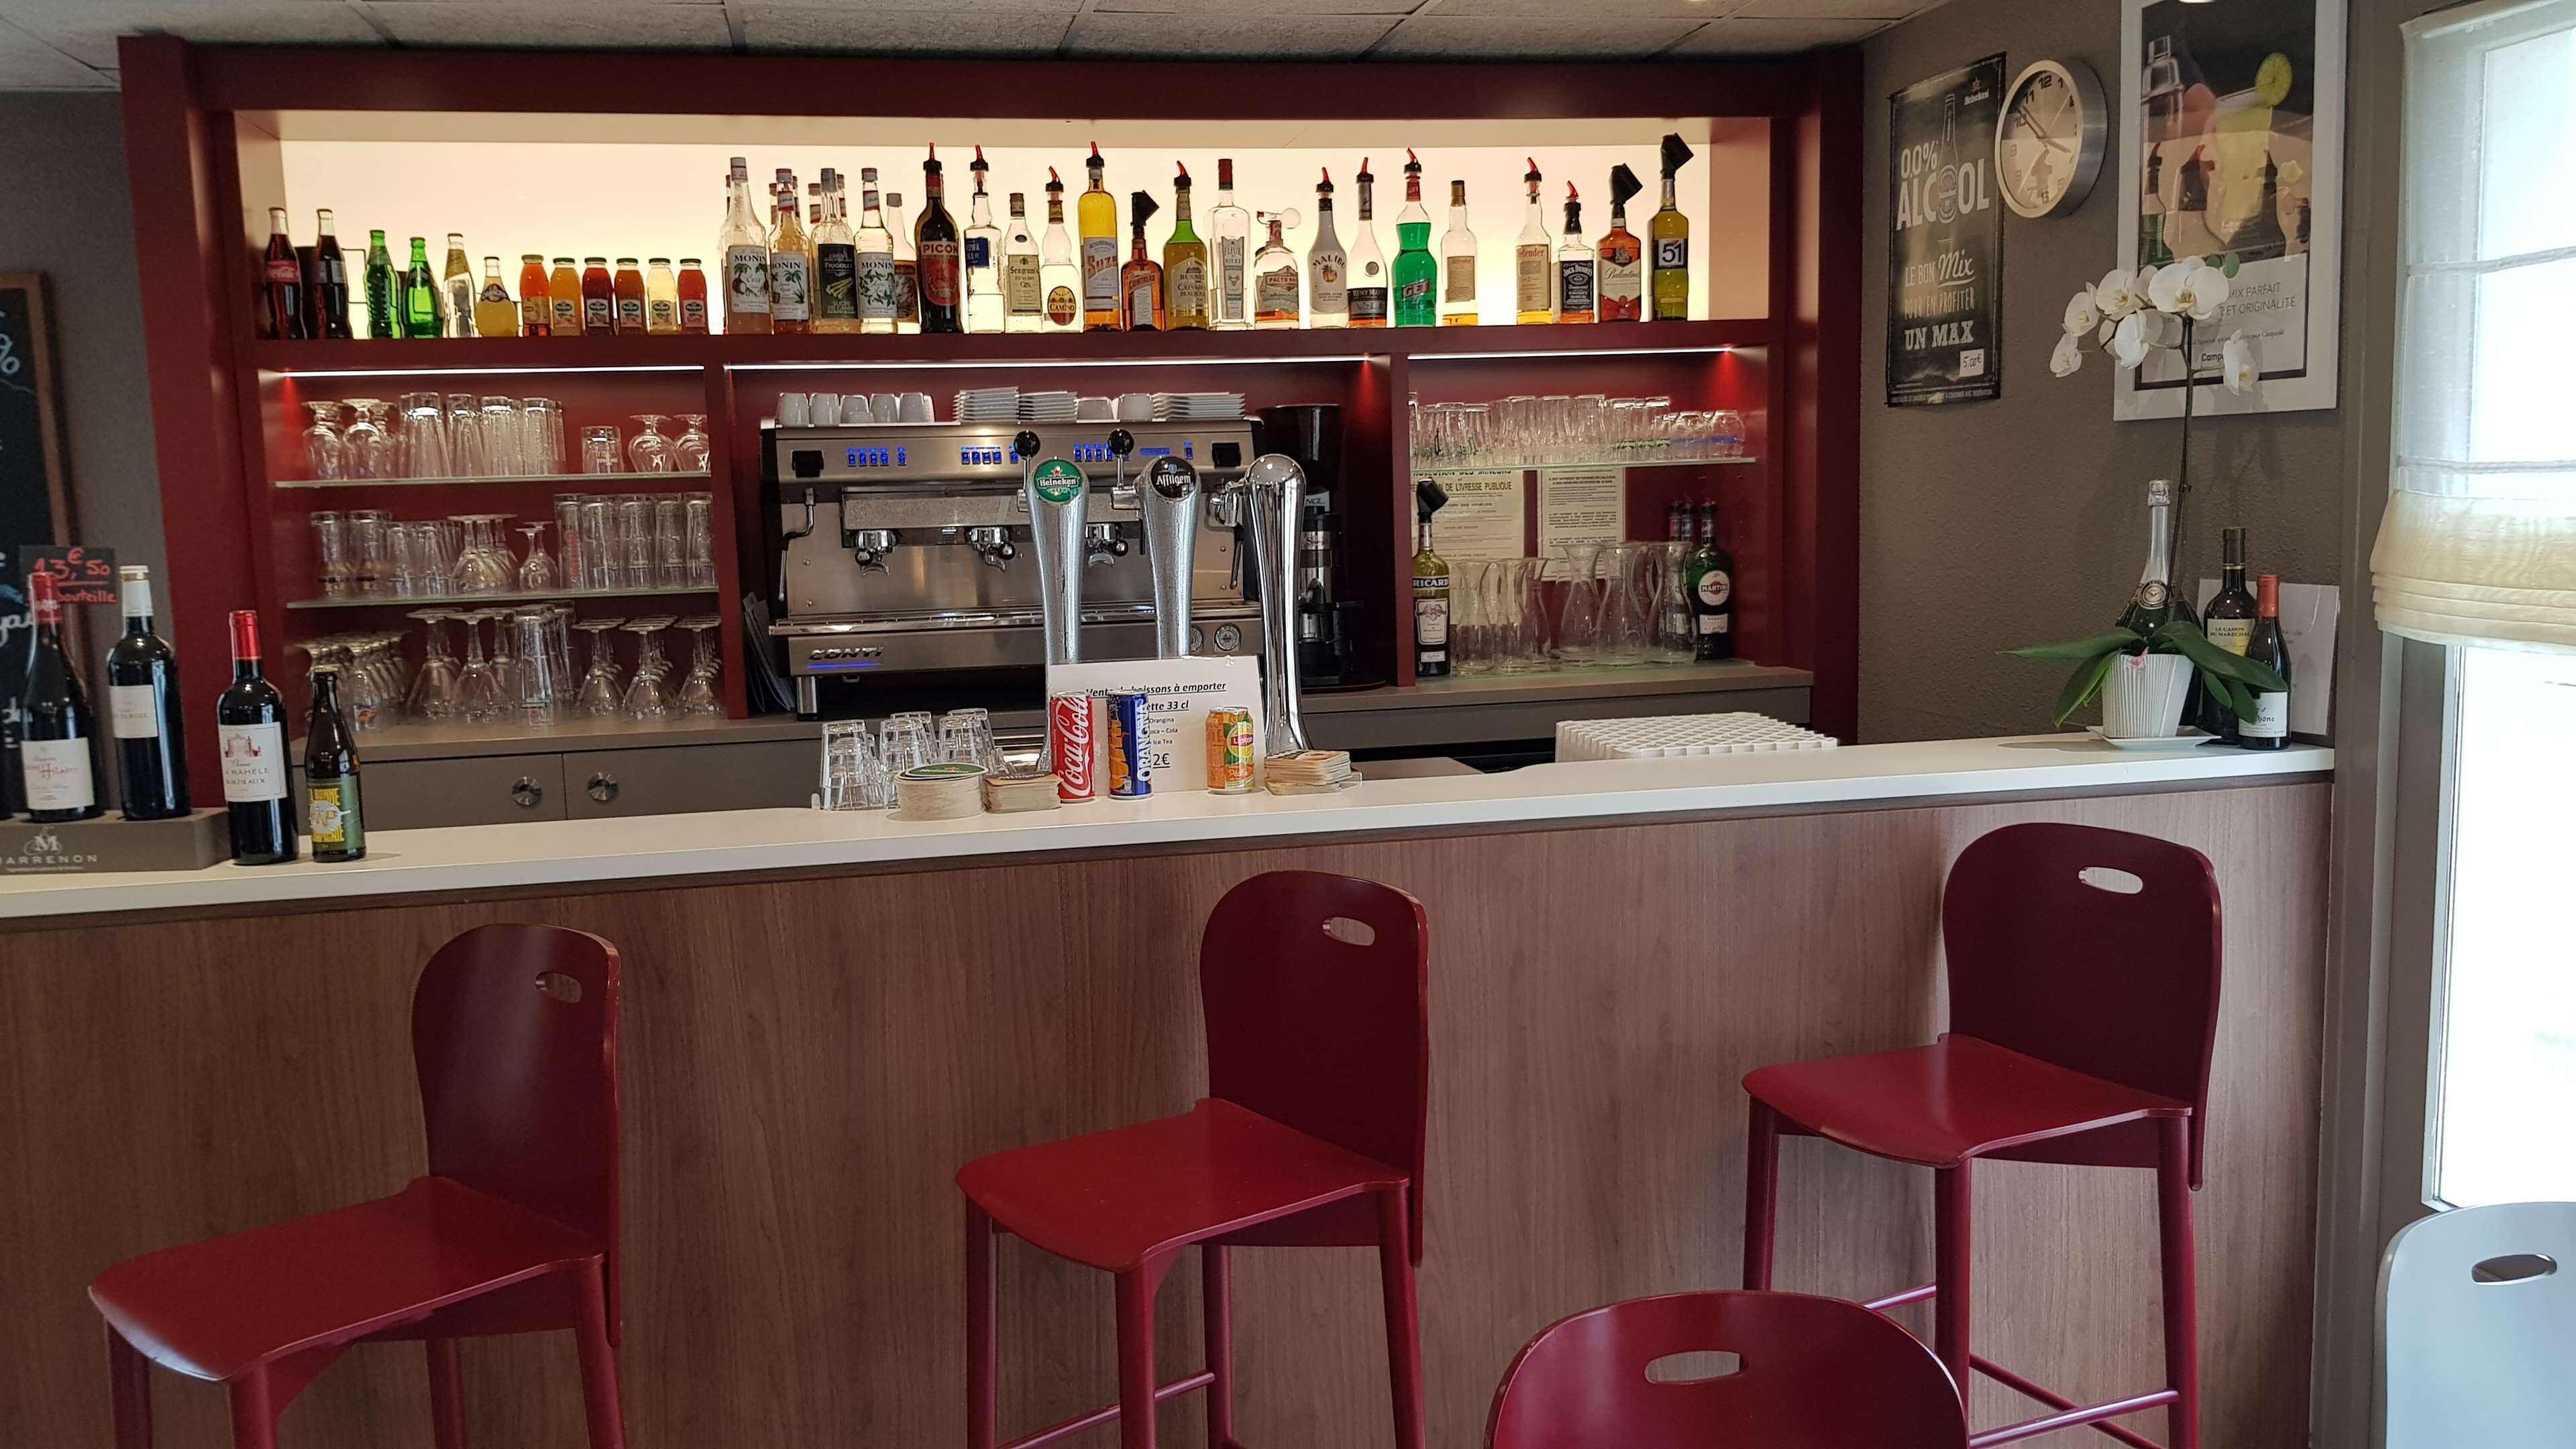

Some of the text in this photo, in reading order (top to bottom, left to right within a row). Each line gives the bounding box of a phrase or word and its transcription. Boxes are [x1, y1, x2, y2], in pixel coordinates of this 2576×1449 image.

[2039, 75, 2052, 90] 12
[2058, 77, 2064, 89] 1
[1964, 89, 1990, 105] Heineken
[2023, 90, 2035, 104] 11
[2014, 113, 2027, 128] 10
[923, 244, 958, 254] PICON
[1519, 248, 1544, 258] efender
[1662, 243, 1682, 263] 51
[735, 254, 766, 262] MONIN
[1313, 254, 1346, 269] MALIBU
[1904, 249, 1975, 286] LE BON Mix
[1403, 280, 1427, 297] GET
[2246, 282, 2282, 297] PARFAIT
[1050, 303, 1075, 312] CAMINO
[1926, 295, 1936, 317] EN
[1939, 287, 1974, 315] PROFITER
[2226, 305, 2236, 315] ET
[1904, 320, 1974, 351] UN MAX
[1040, 478, 1077, 487] Heineken
[1156, 472, 1192, 487] Affligem
[1446, 482, 1454, 492] DE
[1485, 481, 1513, 490] PUBLIQUE
[1413, 579, 1449, 587] RICARD
[809, 647, 885, 660] CONTI
[1086, 682, 1226, 697] Vent issons à emporter
[1168, 701, 1179, 710] 33
[1181, 700, 1189, 709] cl
[1137, 702, 1152, 782] ORANGINA
[1152, 753, 1171, 766] 2€
[0, 854, 97, 865] ARRENON
